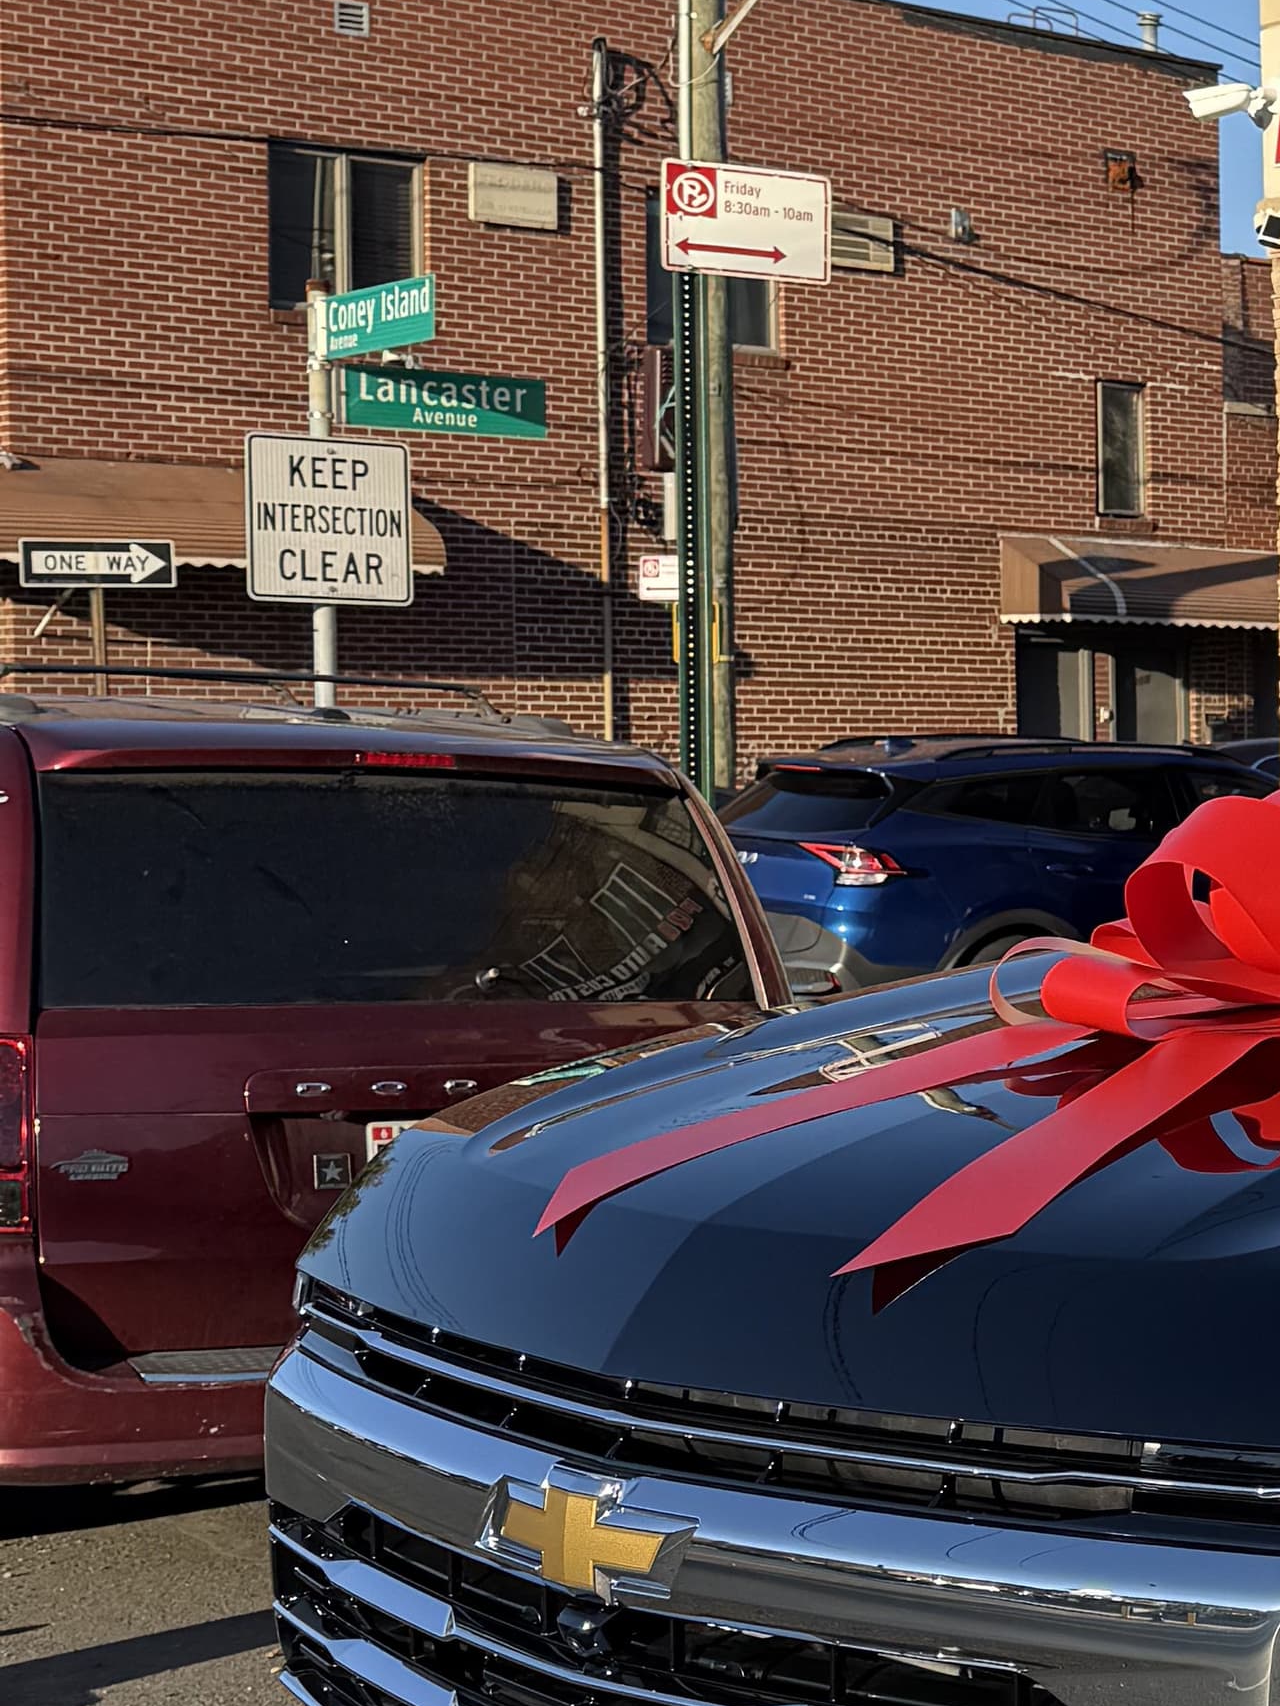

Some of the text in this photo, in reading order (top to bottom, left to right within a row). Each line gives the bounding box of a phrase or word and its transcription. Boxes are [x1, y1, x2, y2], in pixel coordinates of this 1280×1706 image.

[724, 180, 761, 199] Friday
[724, 200, 770, 219] 8:30am
[783, 207, 813, 223] 10am
[328, 279, 431, 334] Coney Island
[330, 332, 358, 352] Avenue
[359, 372, 527, 413] Lancaster
[412, 406, 478, 429] Avenue
[288, 454, 369, 491] KEEP
[256, 501, 402, 539] INTERSECTION
[43, 554, 151, 573] ONE WAY
[278, 548, 384, 585] CLEAR
